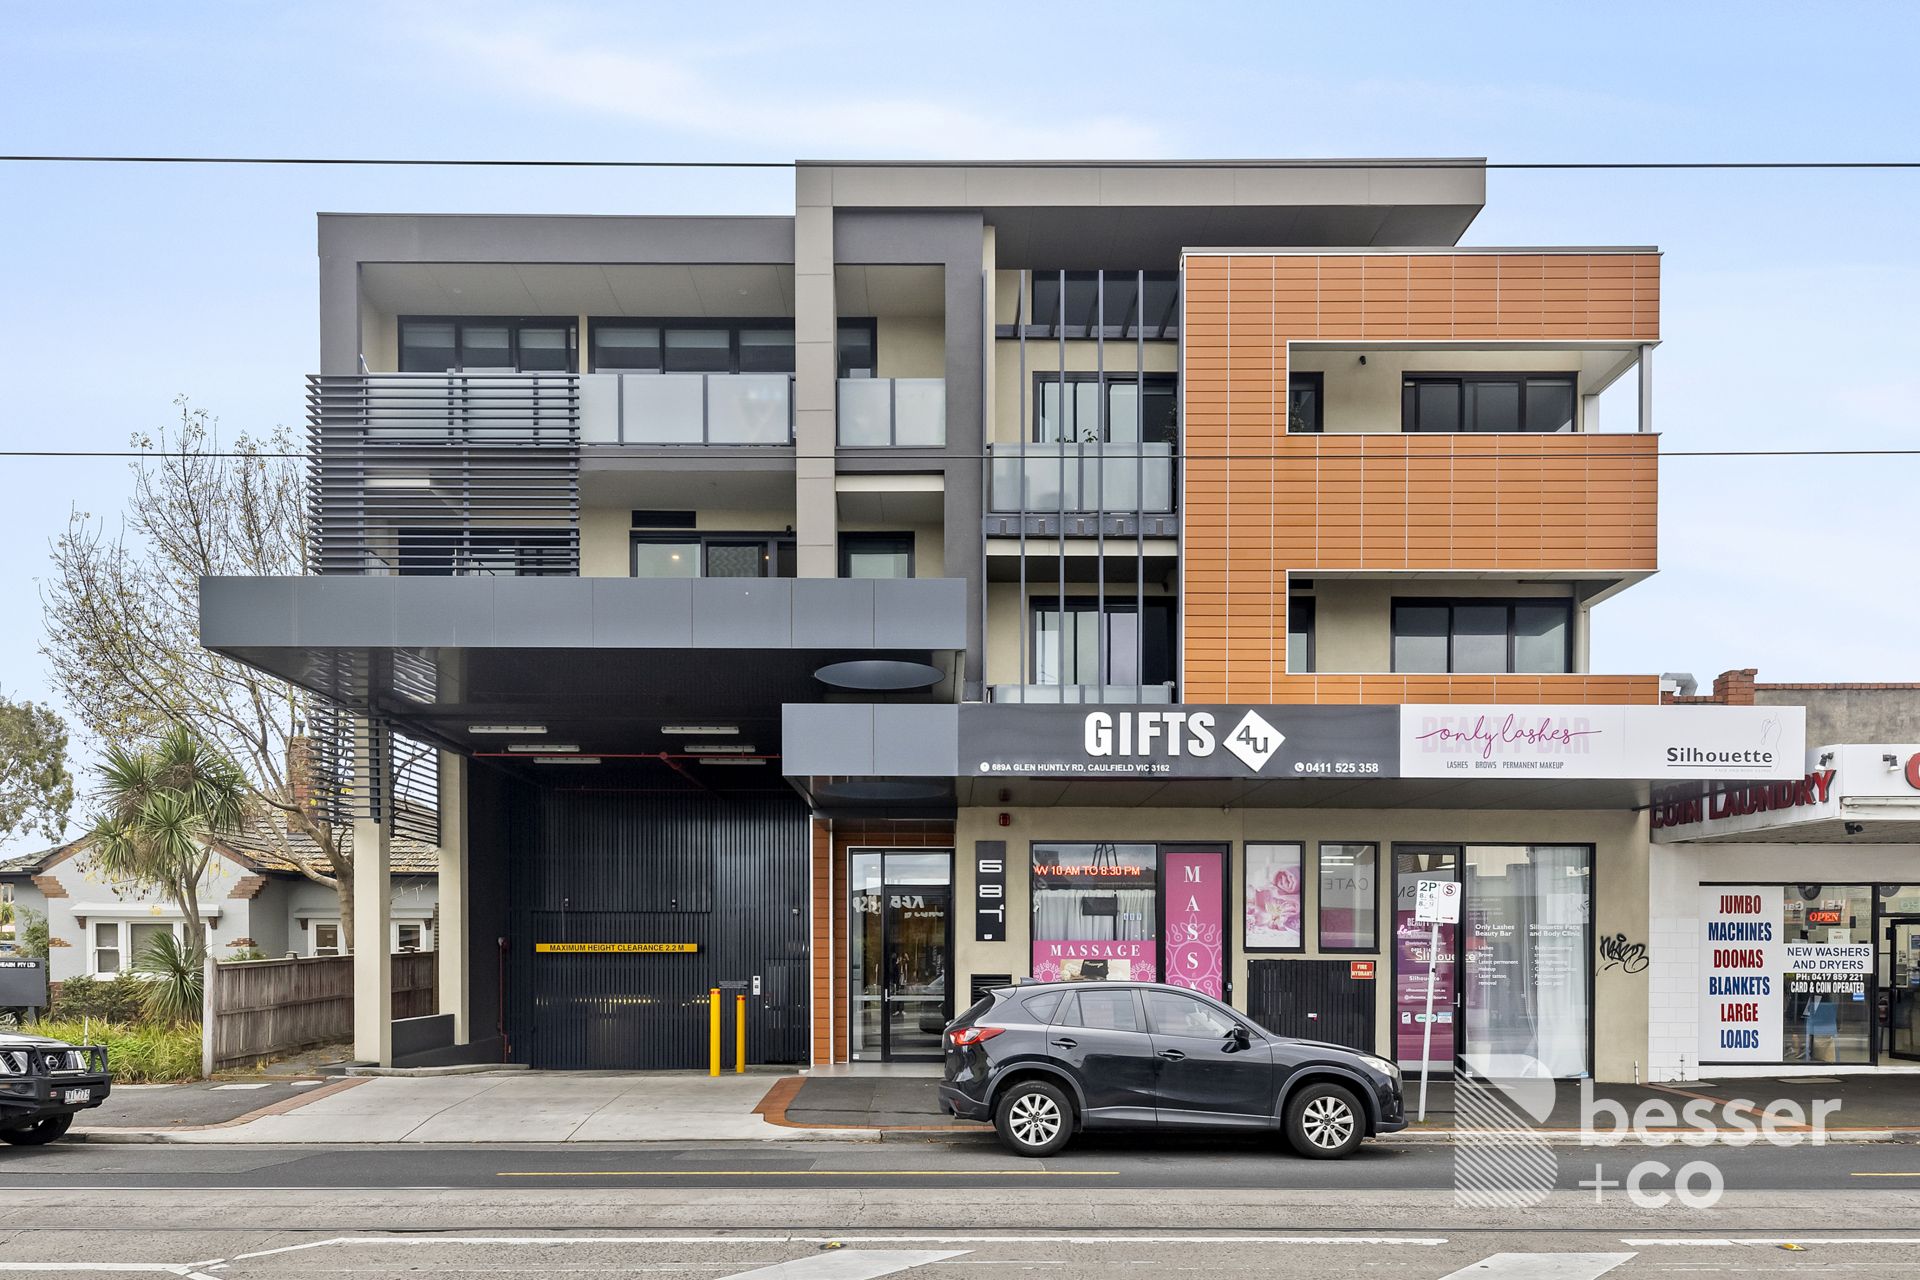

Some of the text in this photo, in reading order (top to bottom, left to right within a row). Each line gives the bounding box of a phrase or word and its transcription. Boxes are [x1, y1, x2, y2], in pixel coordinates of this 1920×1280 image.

[1084, 711, 1216, 757] GIFTS
[1416, 713, 1602, 759] only lashes
[1666, 747, 1773, 763] Silhouette
[1013, 764, 1036, 772] GLEN
[1037, 764, 1070, 772] HUNTLY
[1071, 764, 1087, 773] RD,
[1087, 764, 1134, 772] CAULFIELD
[1135, 764, 1150, 772] VIC
[1151, 764, 1170, 772] 3162
[1306, 763, 1379, 773] 0411 525 358
[1446, 761, 1564, 769] LASHES BROWS PERMANENT MAKEUP
[1651, 769, 1836, 828] COIN LAUNDRY
[1051, 865, 1063, 876] 10
[1064, 865, 1080, 876] AM
[1083, 865, 1098, 876] TO
[1100, 865, 1121, 876] 8:30
[1123, 865, 1141, 876] PM
[1420, 882, 1437, 892] 2P
[1719, 895, 1762, 914] JUMBO
[1808, 911, 1840, 922] OPEN
[1475, 923, 1491, 931] Only
[1708, 922, 1772, 941] MACHINES
[1475, 930, 1498, 938] Beauty
[1543, 930, 1561, 938] Body
[1050, 944, 1141, 956] MASSAGE
[1787, 947, 1870, 957] NEW WASHERS
[1713, 949, 1764, 968] DOONAS
[1793, 960, 1864, 970] AND DRYERS
[1796, 973, 1864, 981] PH: 0417 859 221
[1709, 976, 1771, 996] BLANKETS
[1790, 981, 1865, 993] CARD & COIN OPERATED
[1720, 1003, 1759, 1022] LARGE
[1720, 1029, 1759, 1049] LOADS
